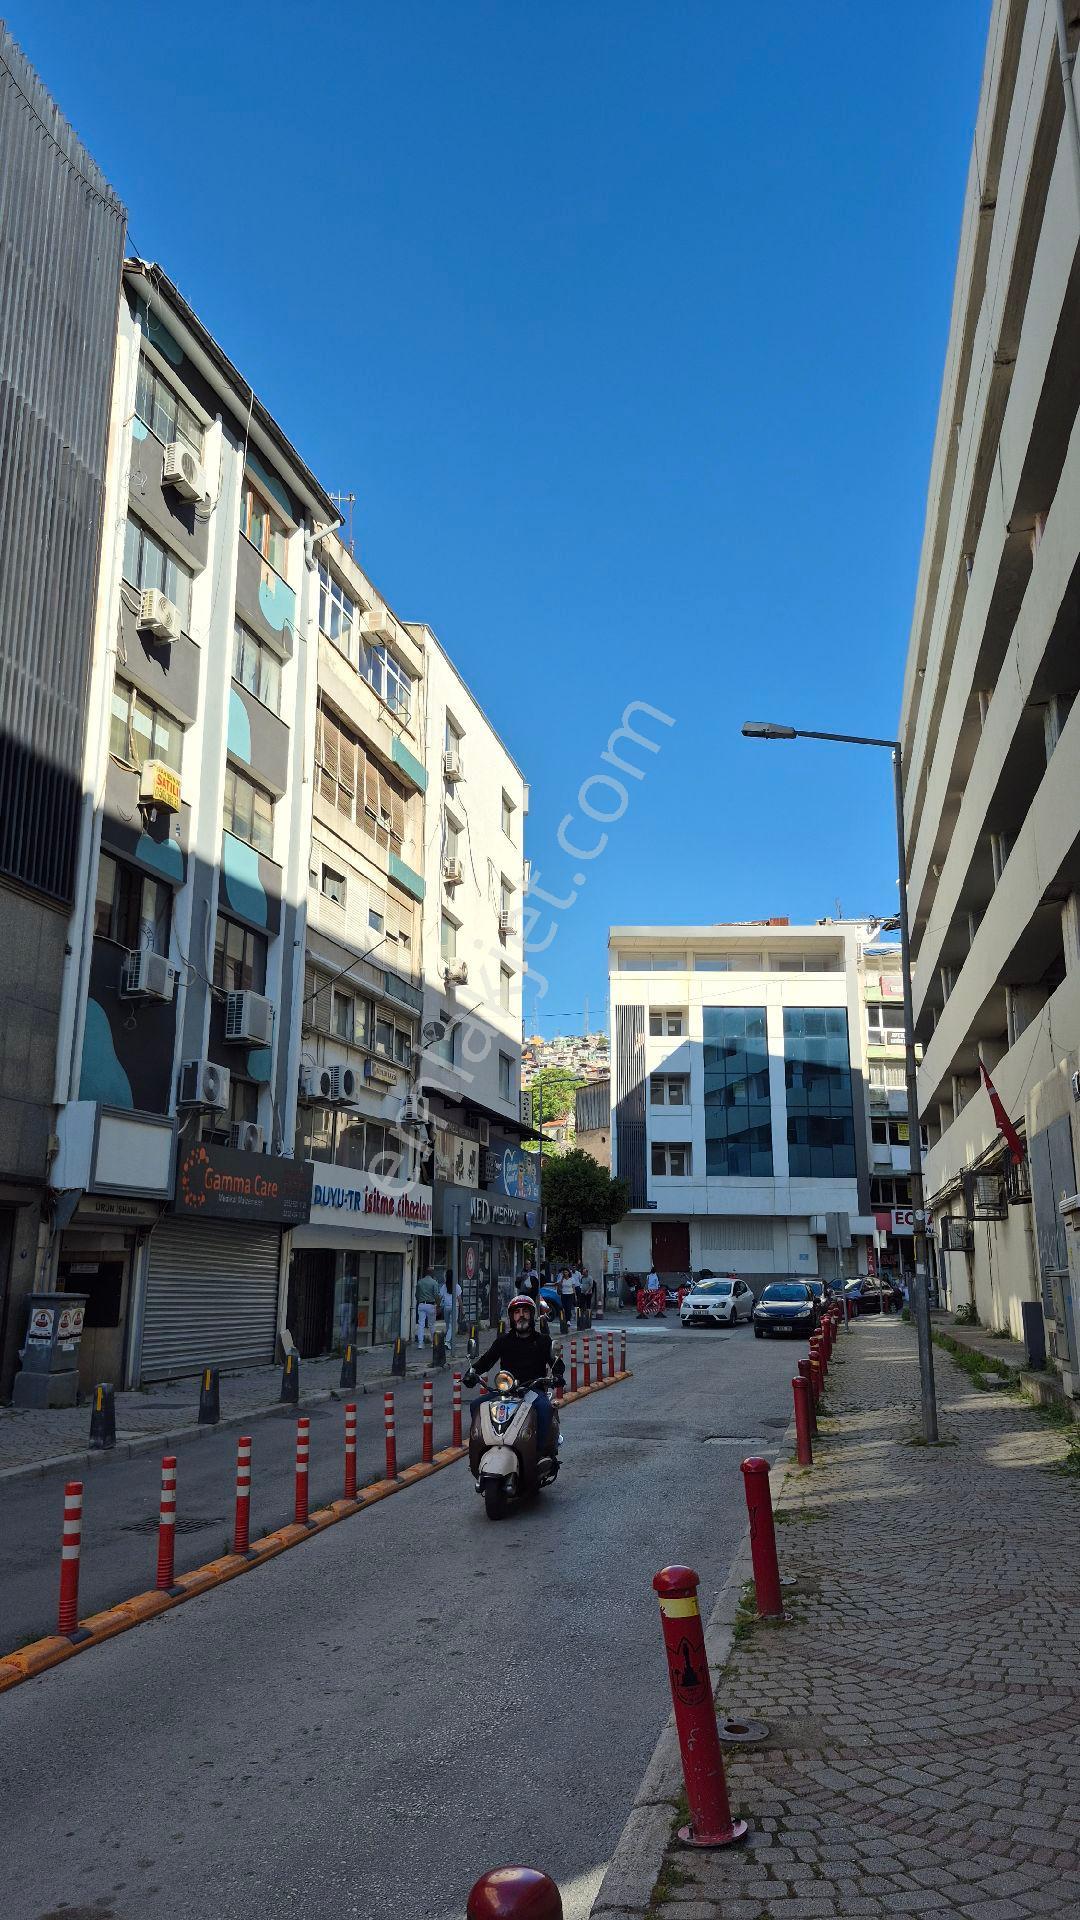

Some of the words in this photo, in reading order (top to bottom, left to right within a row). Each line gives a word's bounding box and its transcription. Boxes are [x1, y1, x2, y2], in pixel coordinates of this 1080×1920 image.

[204, 1167, 251, 1195] Gamma
[254, 1174, 278, 1198] Care
[314, 1184, 361, 1212] DUYU-TR
